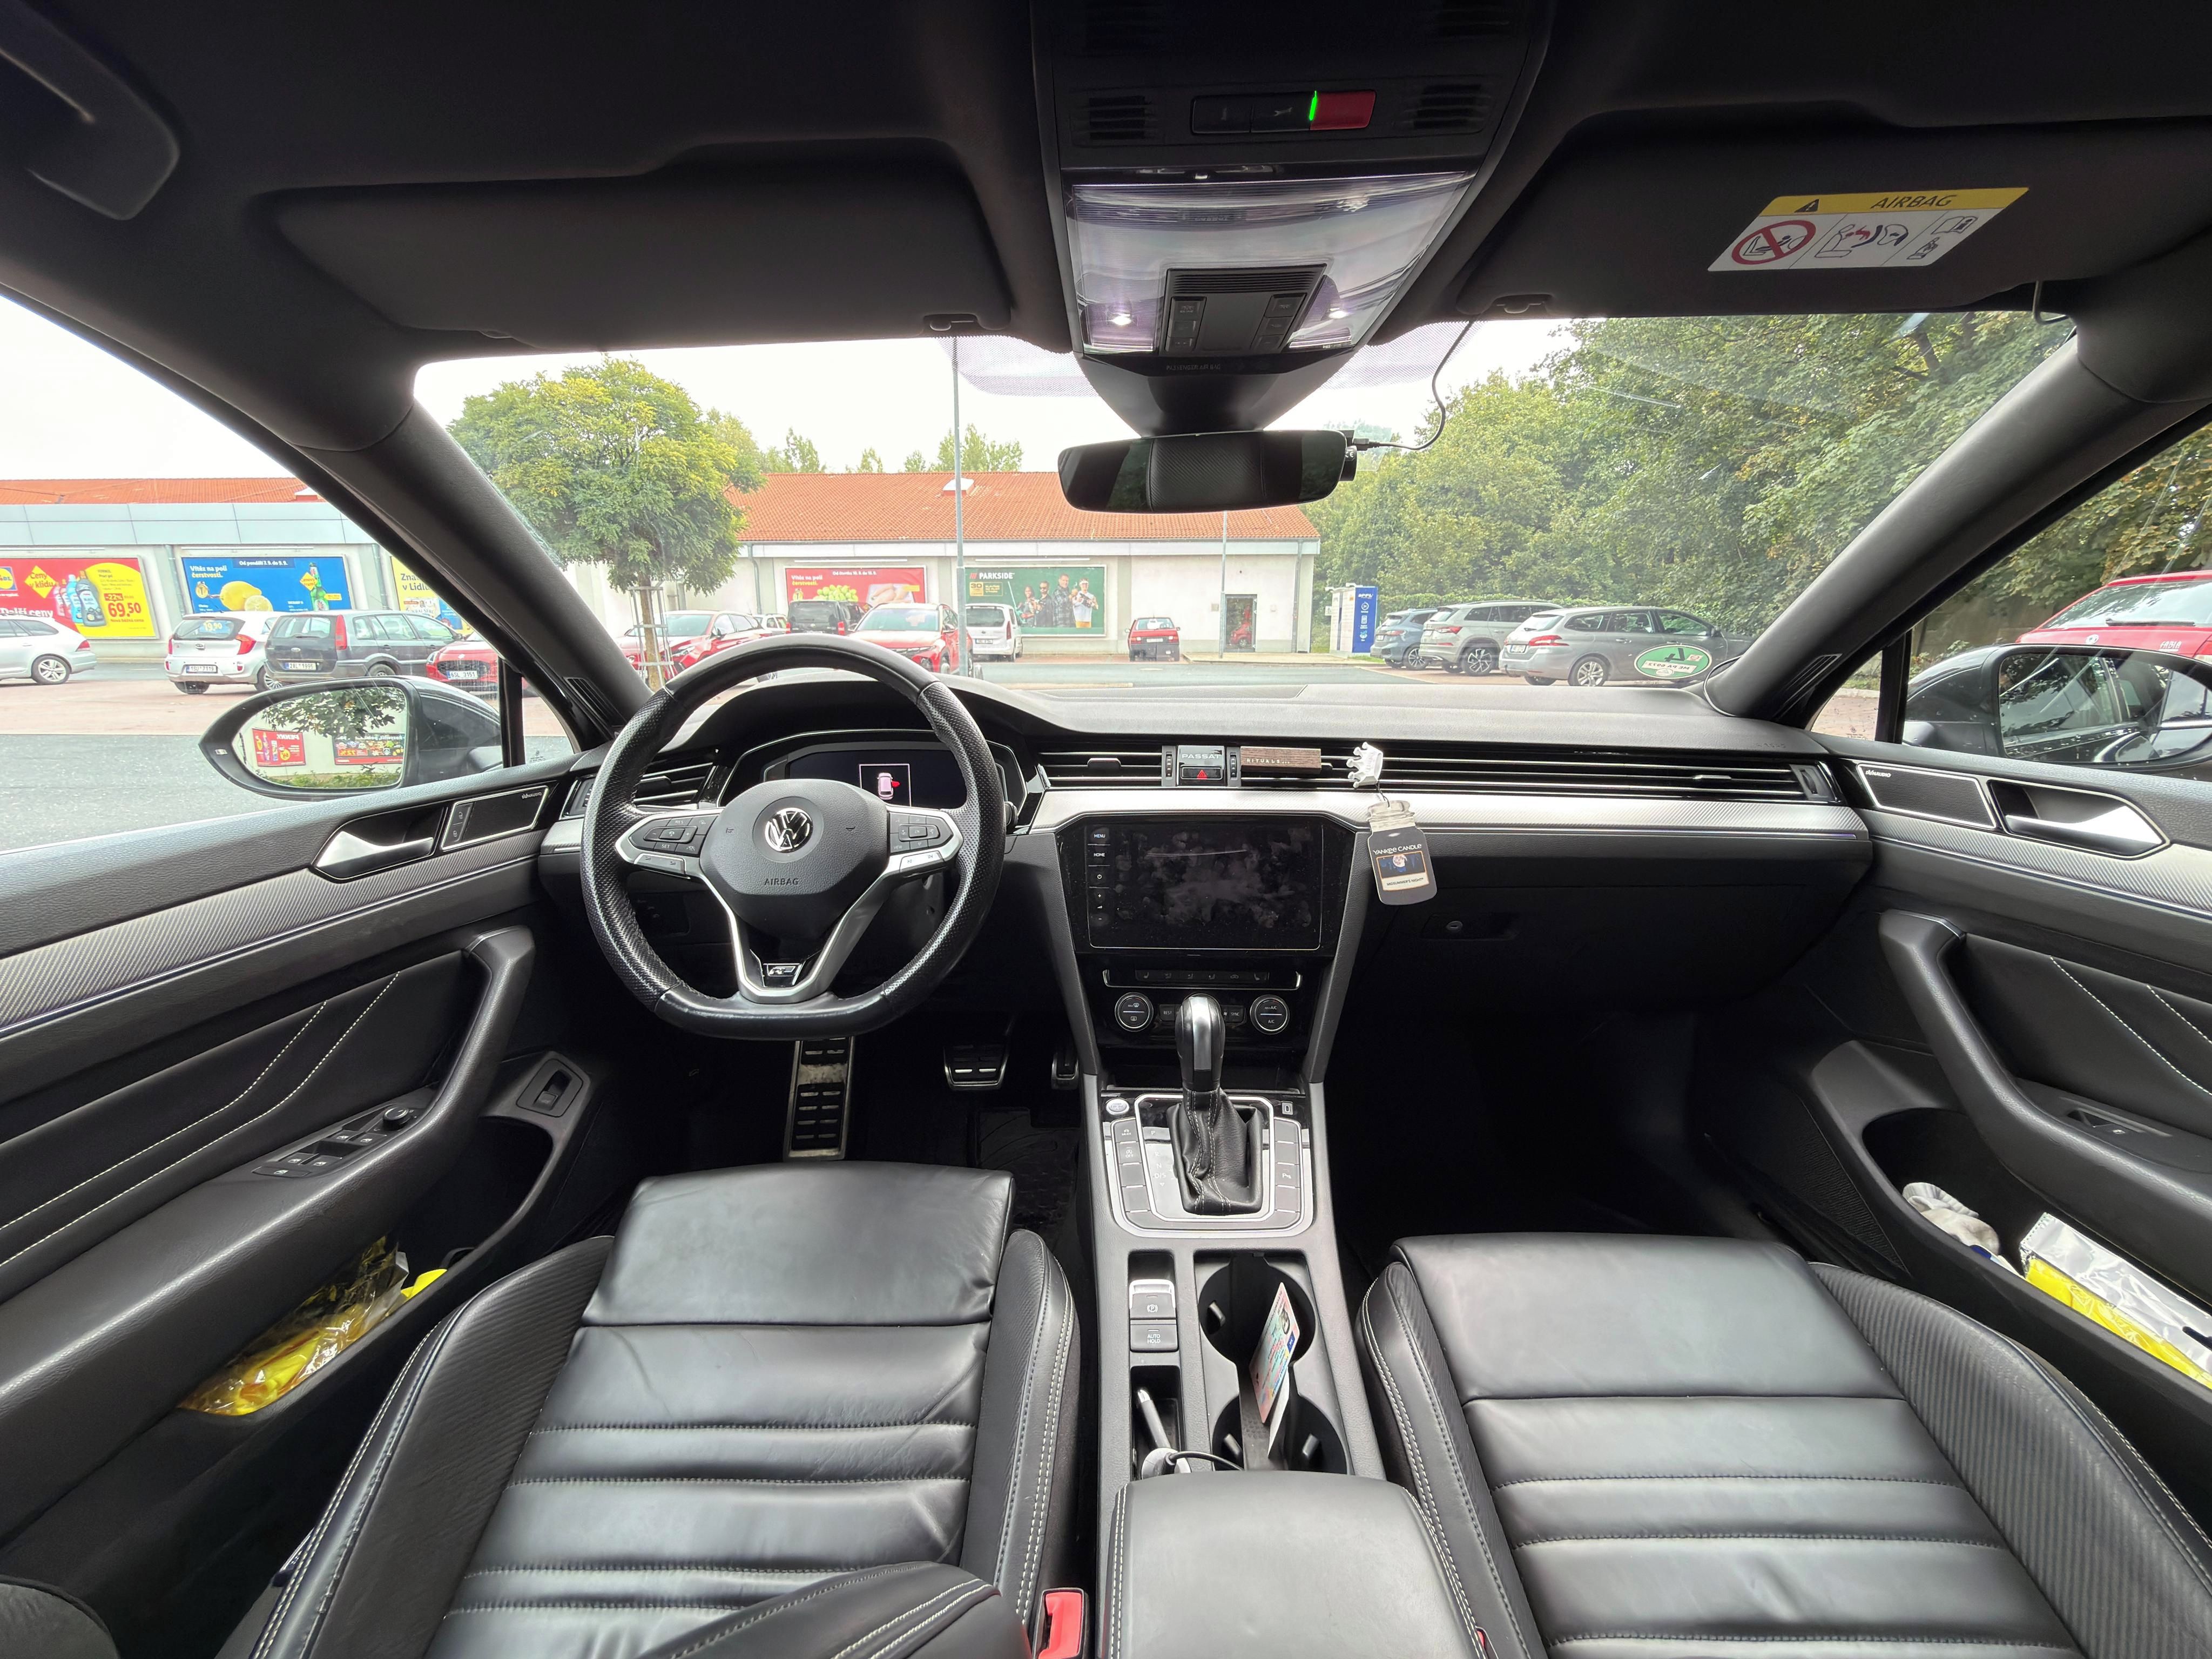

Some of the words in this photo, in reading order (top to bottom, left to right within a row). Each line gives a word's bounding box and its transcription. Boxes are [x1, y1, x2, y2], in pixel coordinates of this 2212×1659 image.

[1870, 194, 1958, 209] AIRBAG
[401, 573, 419, 581] Zna
[108, 602, 141, 617] 69.50
[29, 610, 53, 618] ceny
[1865, 769, 1891, 778] DYNAUDIO
[764, 878, 799, 886] AIRBAG
